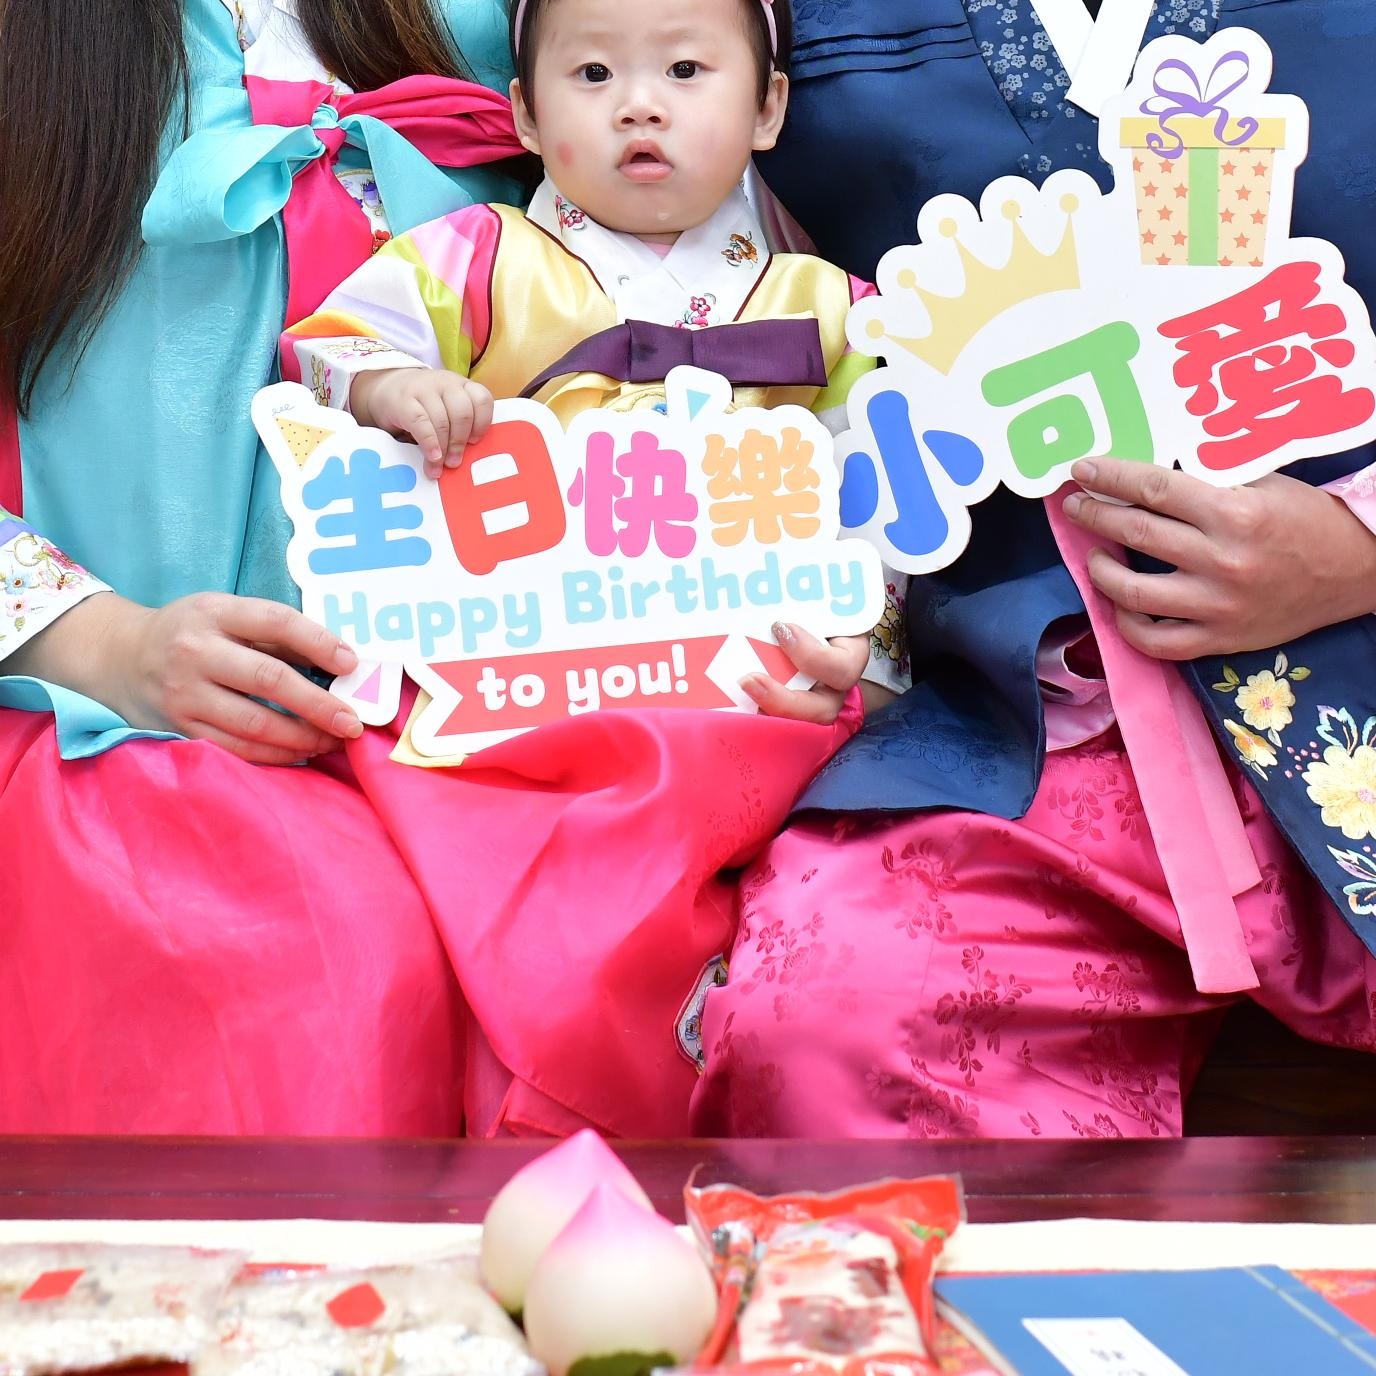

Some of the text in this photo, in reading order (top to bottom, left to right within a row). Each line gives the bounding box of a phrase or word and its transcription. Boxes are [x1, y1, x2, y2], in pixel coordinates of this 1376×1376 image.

[839, 262, 1376, 557] 小可愛
[302, 419, 821, 576] 生日快樂
[324, 552, 865, 657] Happy Birthday
[476, 644, 688, 715] to you!
